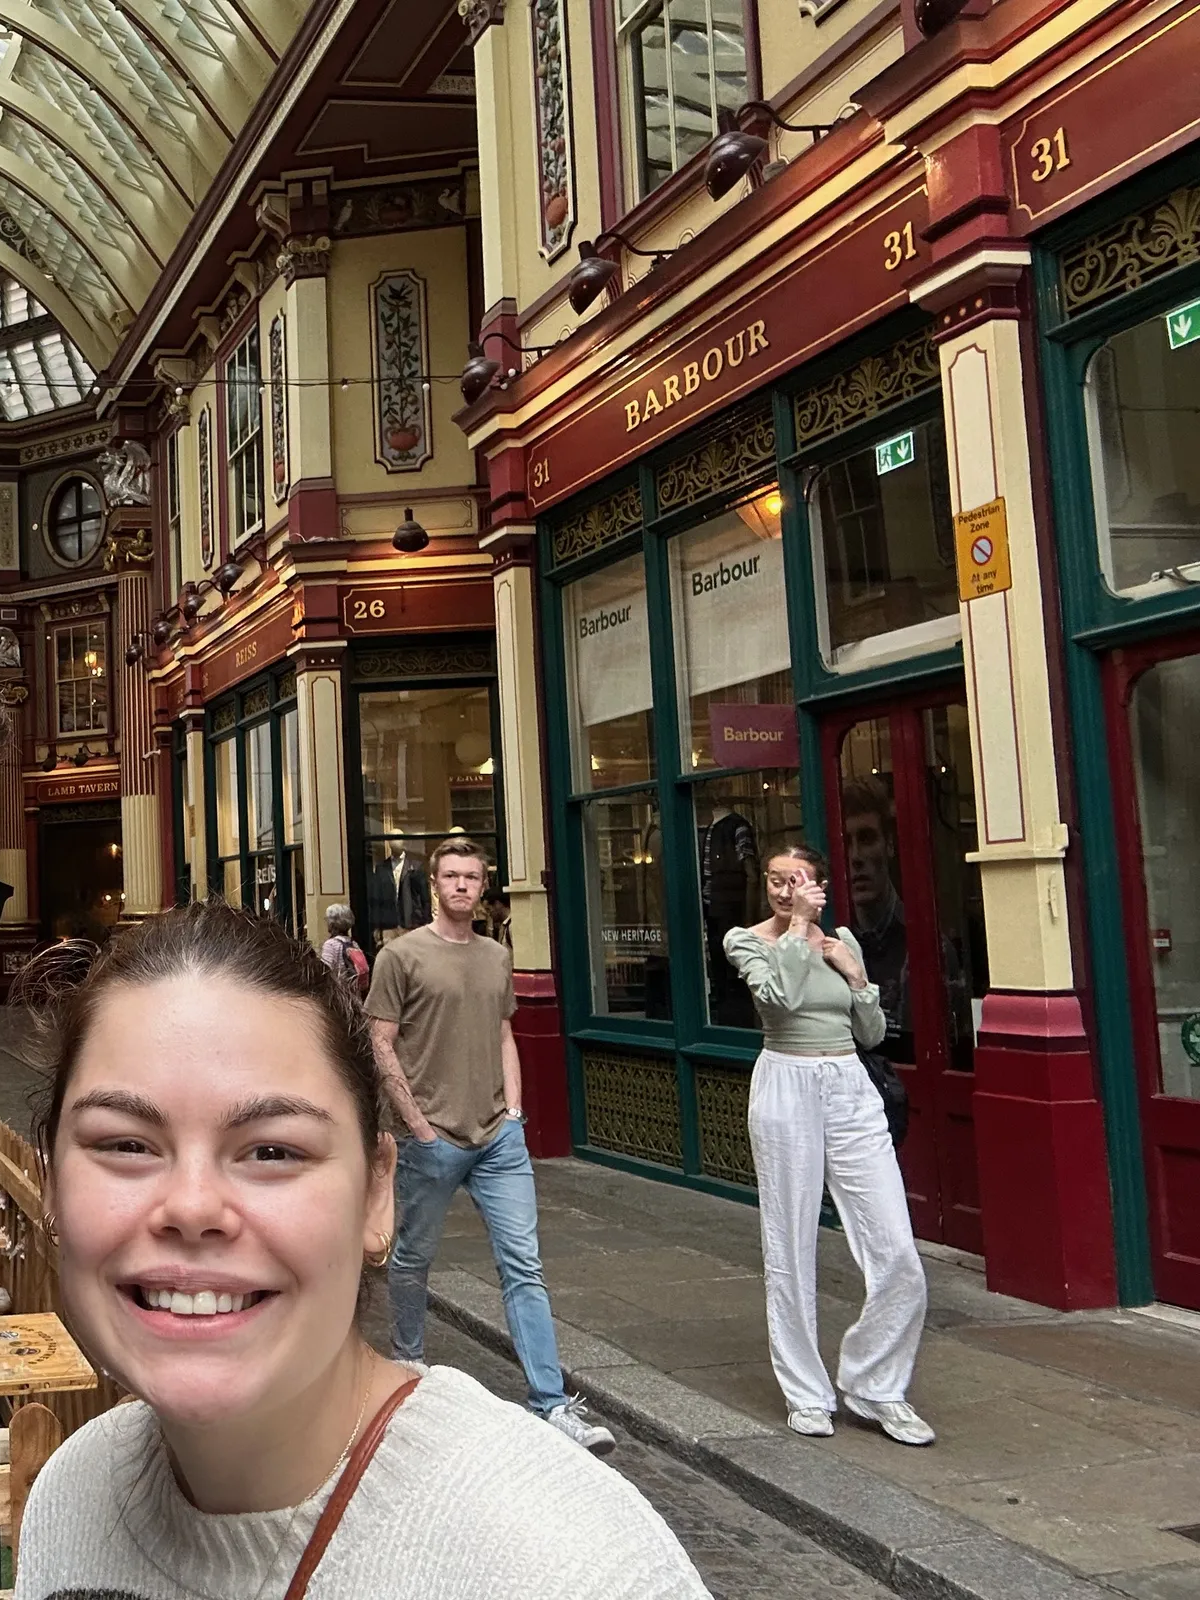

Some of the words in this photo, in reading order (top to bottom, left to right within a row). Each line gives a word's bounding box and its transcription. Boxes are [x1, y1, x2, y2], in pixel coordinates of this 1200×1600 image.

[1030, 126, 1070, 182] 31
[883, 221, 917, 271] 31
[624, 319, 769, 433] BARBOUR
[534, 457, 550, 488] 31
[958, 504, 1000, 525] Pedestrian
[970, 521, 990, 533] Zone
[692, 554, 760, 597] Barbour
[971, 572, 980, 583] At
[983, 568, 997, 580] any
[976, 582, 994, 595] time
[353, 599, 385, 620] 26
[579, 604, 631, 640] Barbour
[235, 640, 257, 668] REISS
[723, 726, 784, 742] Barbour
[48, 785, 76, 797] LAMB
[79, 782, 118, 795] TAVERN
[601, 929, 619, 943] NEW
[621, 929, 662, 943] HERITAGE
